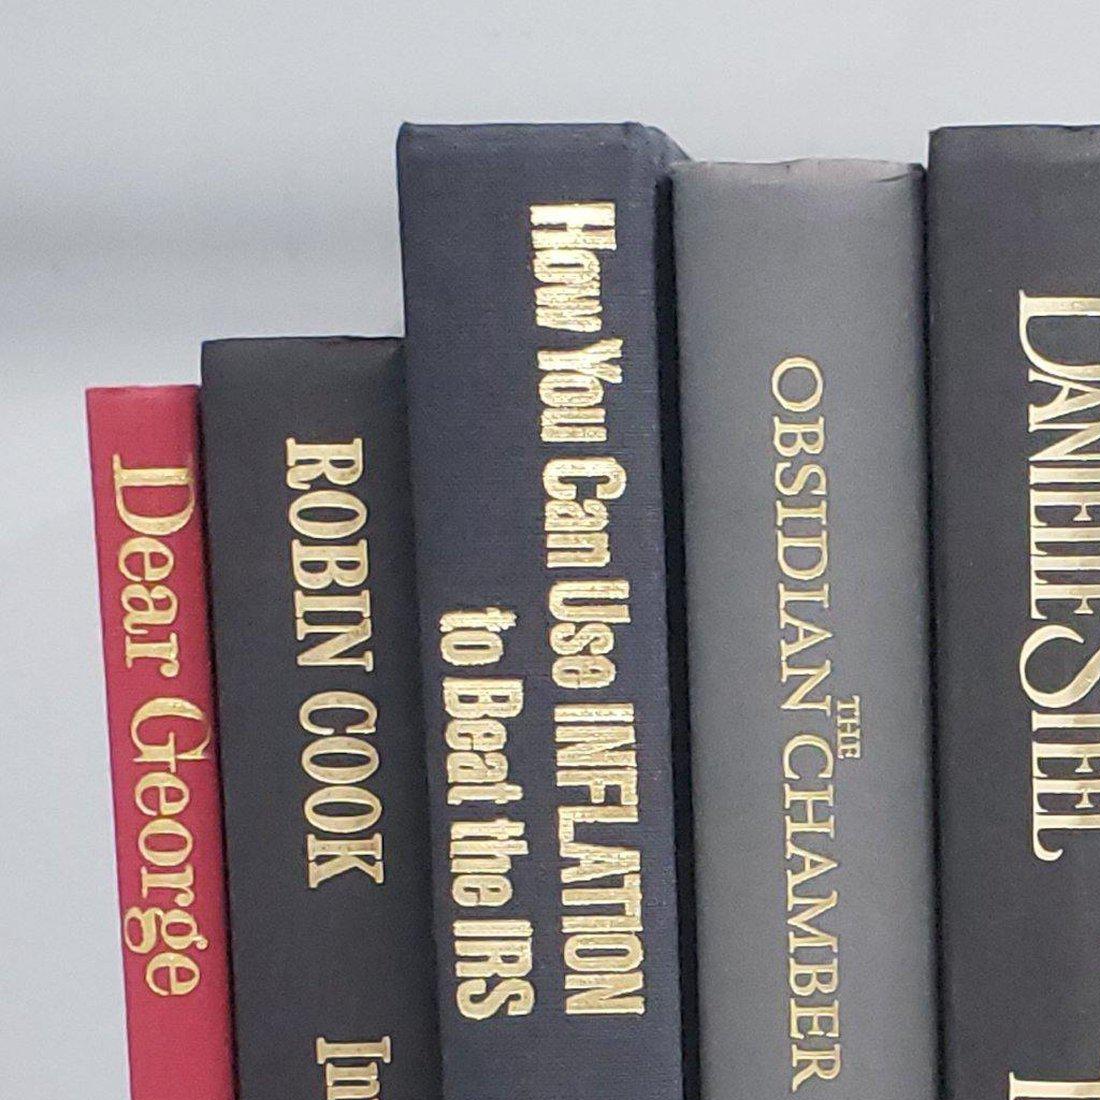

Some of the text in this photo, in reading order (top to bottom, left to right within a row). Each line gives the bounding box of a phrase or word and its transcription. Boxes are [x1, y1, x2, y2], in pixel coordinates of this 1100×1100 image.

[112, 453, 214, 998] Dear George
[285, 437, 384, 889] ROBIN COOK
[439, 607, 535, 1021] to Beat the IRS
[529, 202, 646, 1015] How You Can Use INFLATION
[771, 357, 843, 1092] OBSIDIAN CHAMBER
[835, 695, 861, 760] THE
